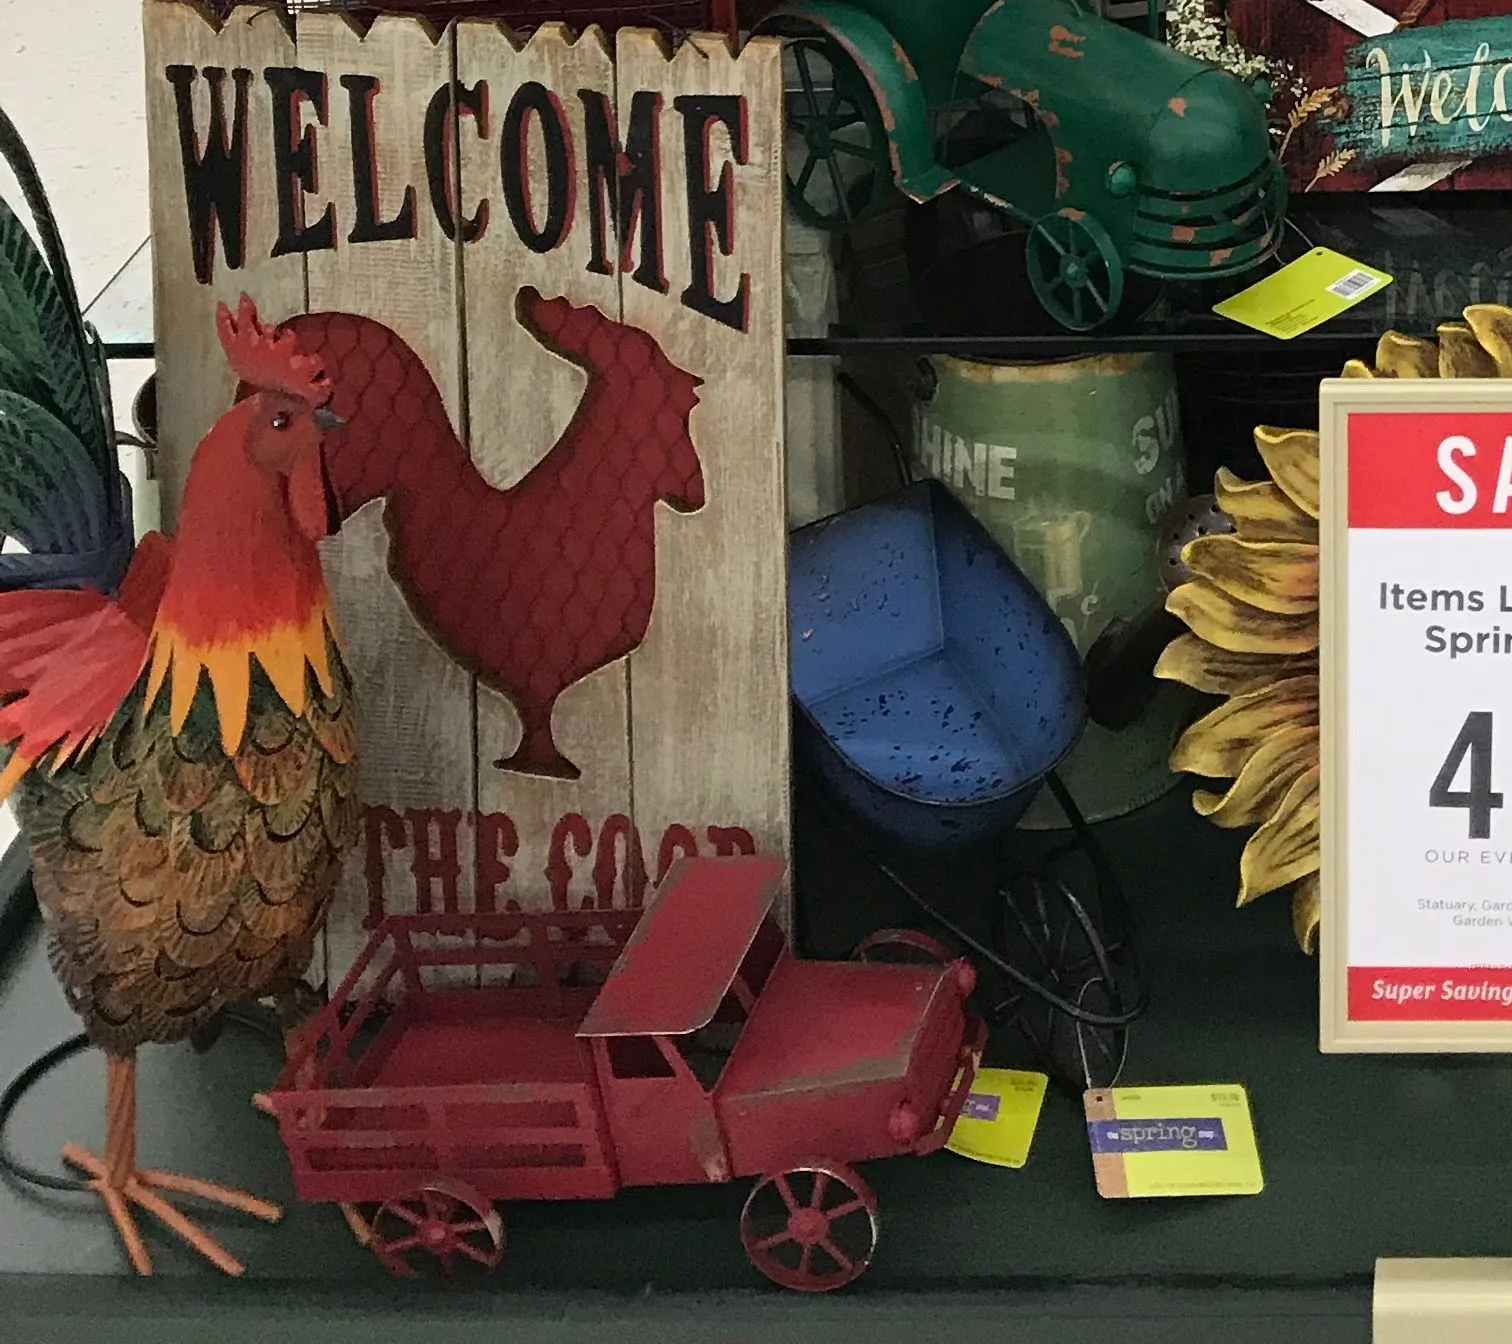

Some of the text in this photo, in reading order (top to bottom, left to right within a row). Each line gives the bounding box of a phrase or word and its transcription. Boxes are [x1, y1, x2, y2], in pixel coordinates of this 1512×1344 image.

[164, 63, 750, 334] WELCOME
[912, 406, 1018, 500] HINE
[1379, 582, 1485, 612] Items
[1425, 849, 1471, 865] OUR
[361, 805, 757, 949] THE CO
[1417, 898, 1478, 915] Statuary,
[1452, 914, 1503, 929] Garden
[1371, 979, 1436, 1005] Super
[1119, 1123, 1198, 1149] spring
